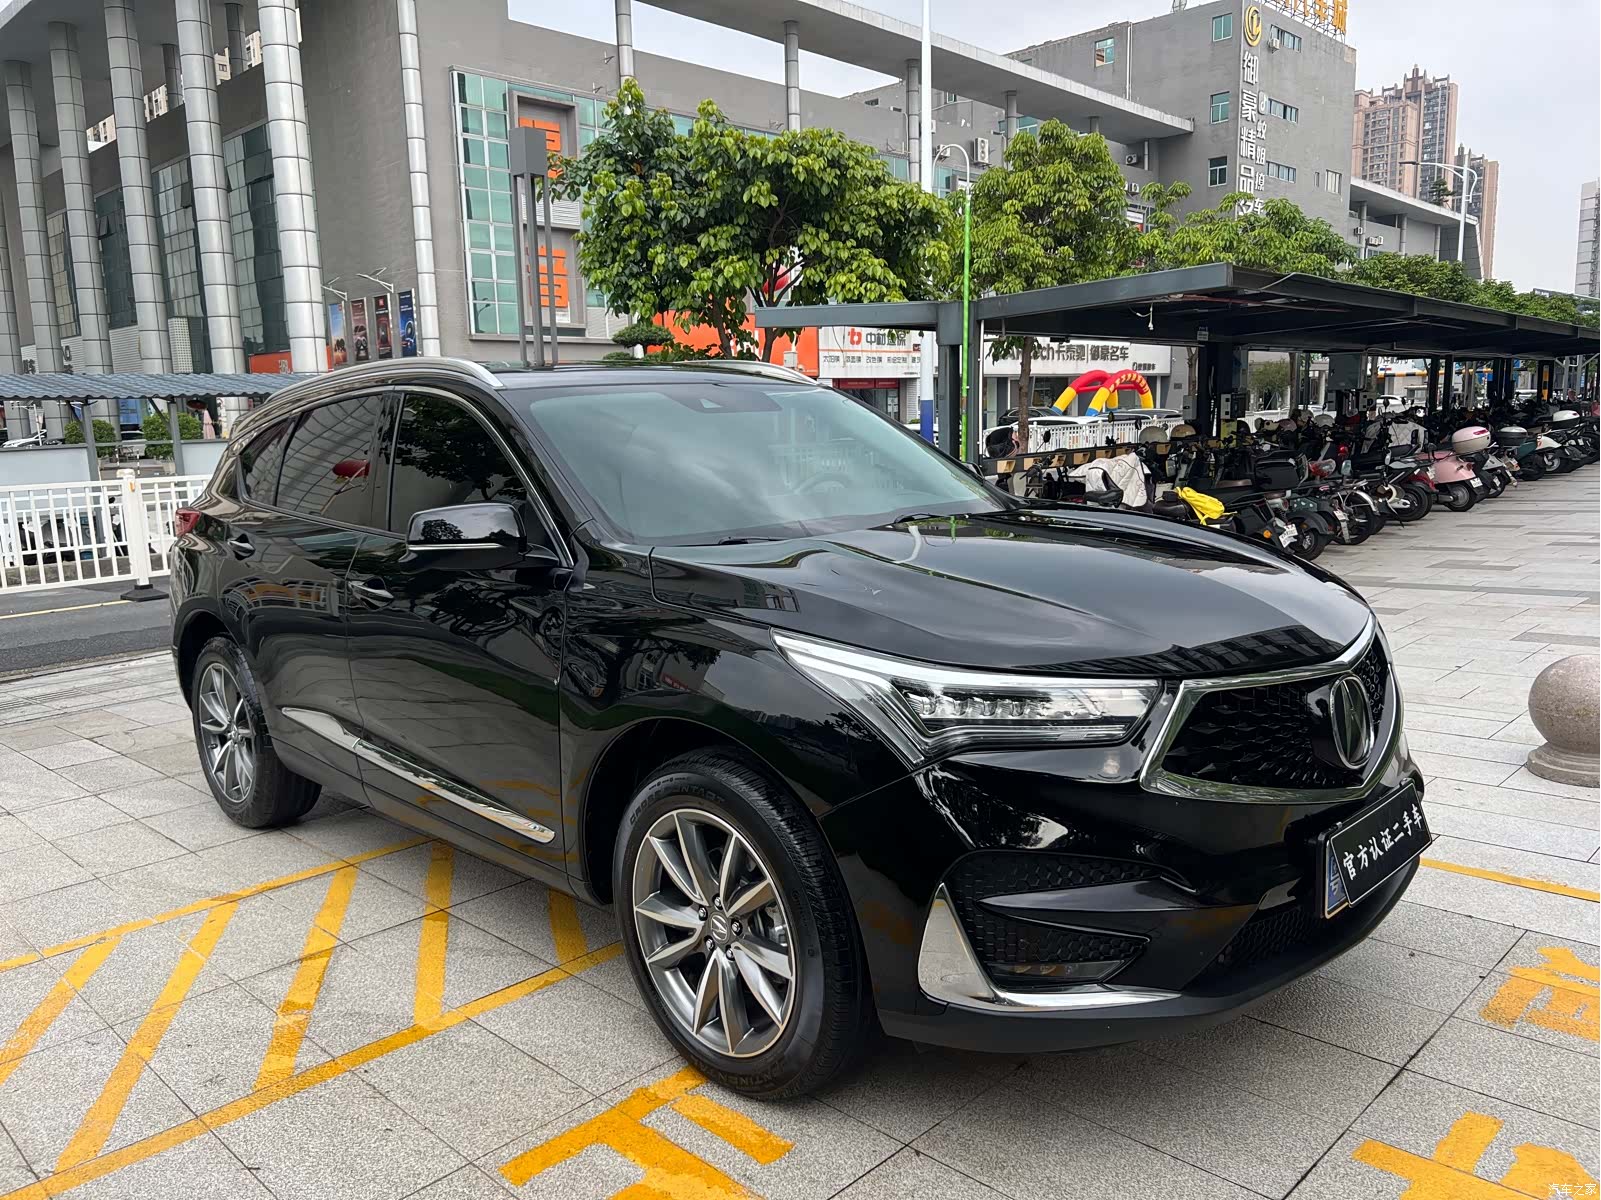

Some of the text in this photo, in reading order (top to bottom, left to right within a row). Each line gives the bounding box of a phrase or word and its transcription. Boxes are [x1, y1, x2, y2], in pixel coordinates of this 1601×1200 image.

[1090, 345, 1129, 361] 御豪名车
[1343, 803, 1422, 880] 官方认证二手车
